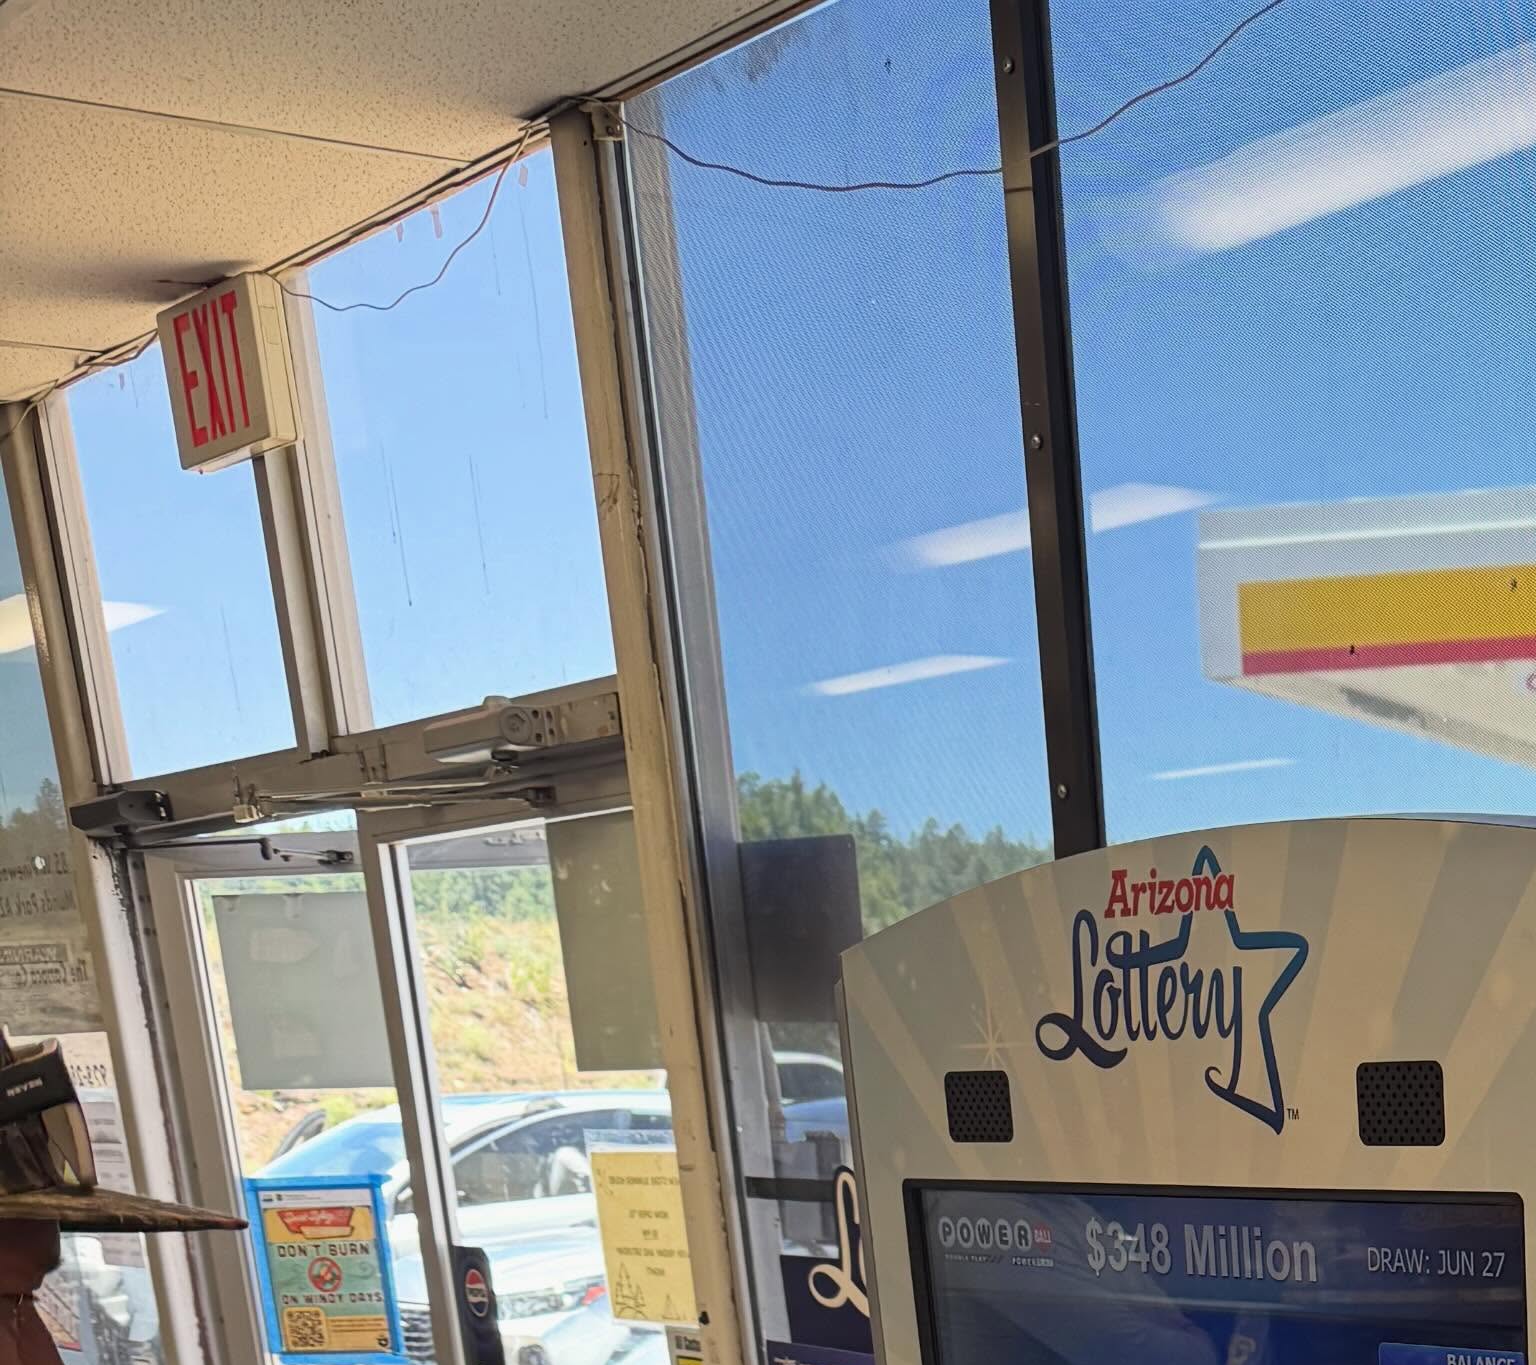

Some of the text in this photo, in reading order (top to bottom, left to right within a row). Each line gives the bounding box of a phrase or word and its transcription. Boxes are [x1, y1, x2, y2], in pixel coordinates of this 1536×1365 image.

[172, 289, 250, 449] EXIT
[1035, 869, 1275, 1120] Arizona Lottery
[277, 1243, 371, 1257] DON'T BURN
[1085, 1216, 1171, 1277] $348
[1184, 1224, 1317, 1283] Million
[1366, 1245, 1431, 1275] DRAW:
[1437, 1248, 1473, 1276] JUN
[1479, 1251, 1505, 1278] 27
[282, 1292, 383, 1305] ON WINDY DAYS
